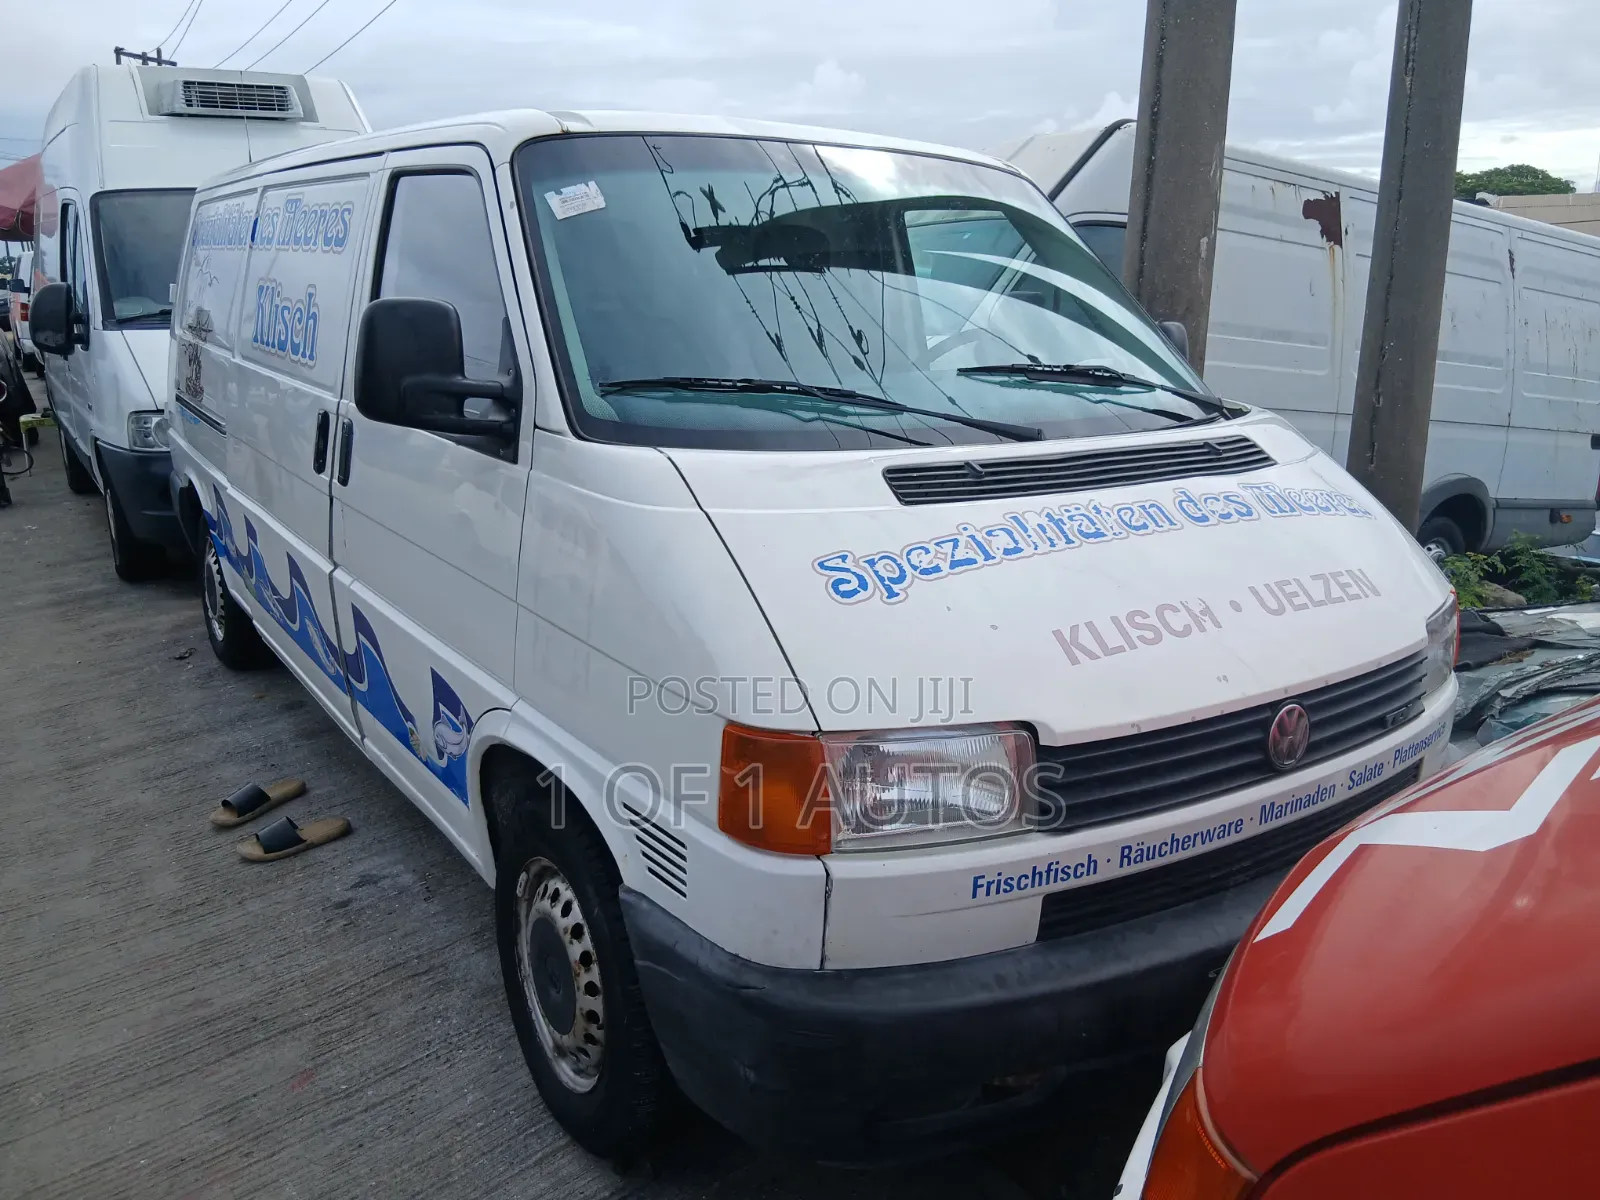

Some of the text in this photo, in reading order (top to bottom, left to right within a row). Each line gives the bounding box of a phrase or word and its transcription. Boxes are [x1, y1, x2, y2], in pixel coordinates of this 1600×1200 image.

[251, 277, 319, 368] Klisch
[1173, 487, 1260, 527] des
[1052, 568, 1381, 666] KLISCH UELZEN
[971, 720, 1448, 899] Frischfisch Räucherware Marinaden Salate Plattenservice
